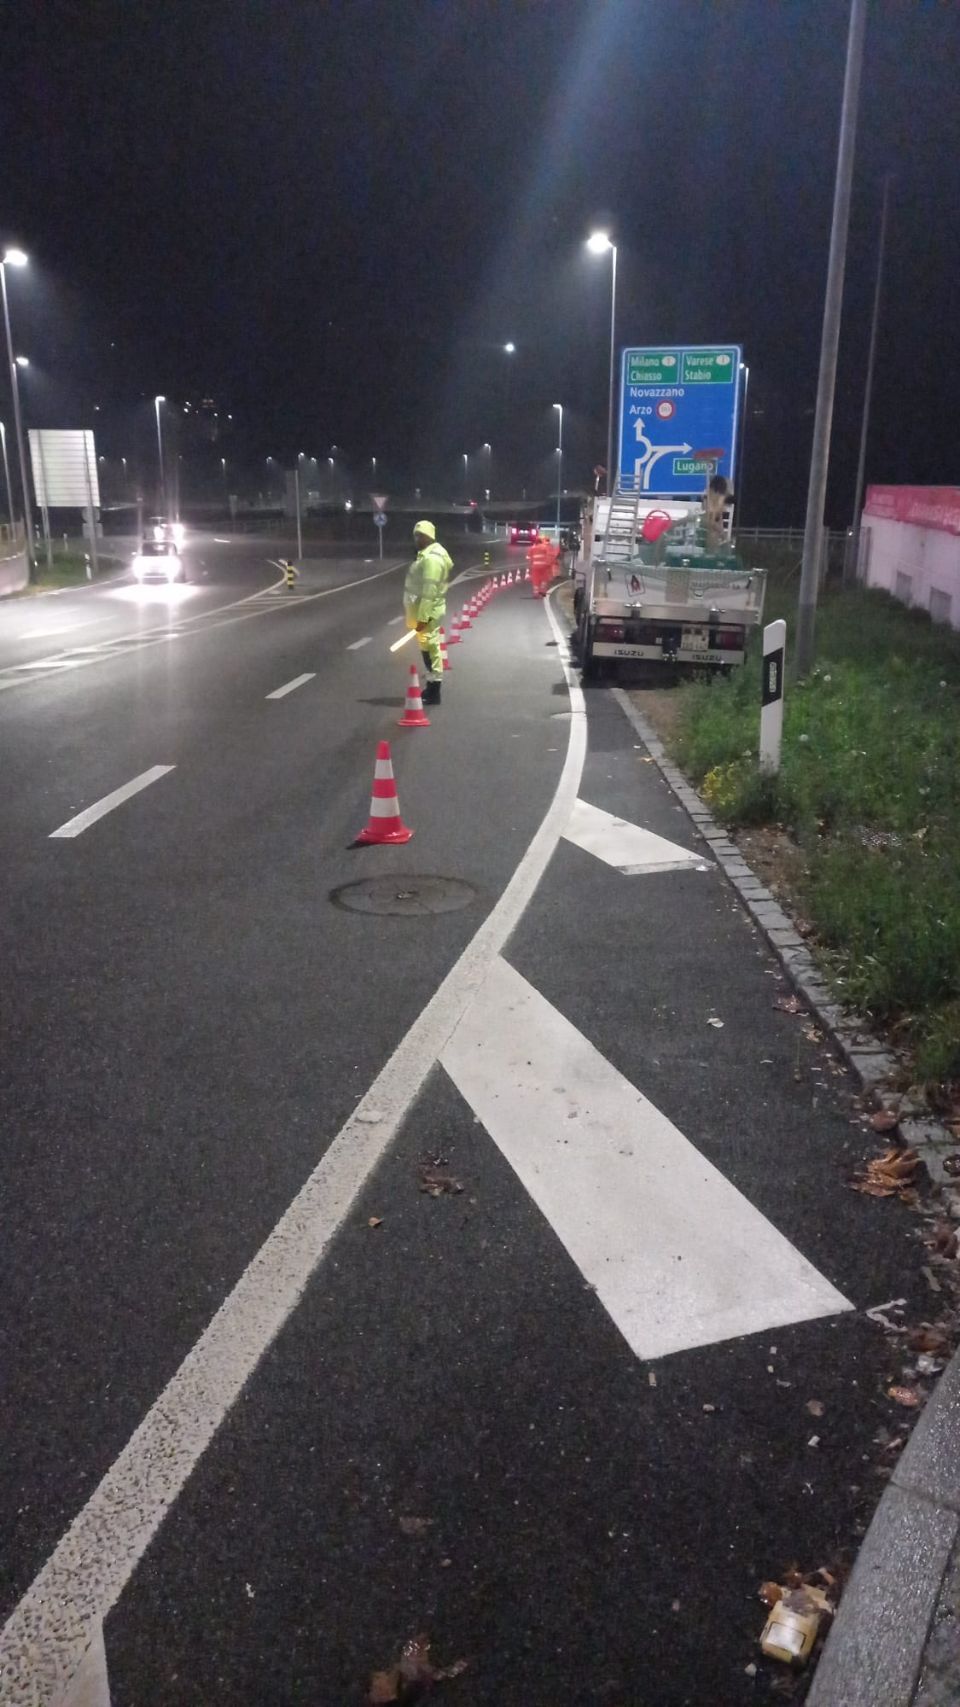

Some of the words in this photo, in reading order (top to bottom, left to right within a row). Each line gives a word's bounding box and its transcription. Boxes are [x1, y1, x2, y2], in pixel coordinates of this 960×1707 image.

[631, 356, 659, 366] Milano
[686, 356, 714, 366] Varese
[631, 370, 662, 381] Chiasso
[685, 369, 711, 380] Stabio
[630, 387, 685, 397] Novazzano
[629, 405, 652, 415] Arzo
[677, 461, 714, 473] Lugano
[614, 649, 644, 657] ISUZU
